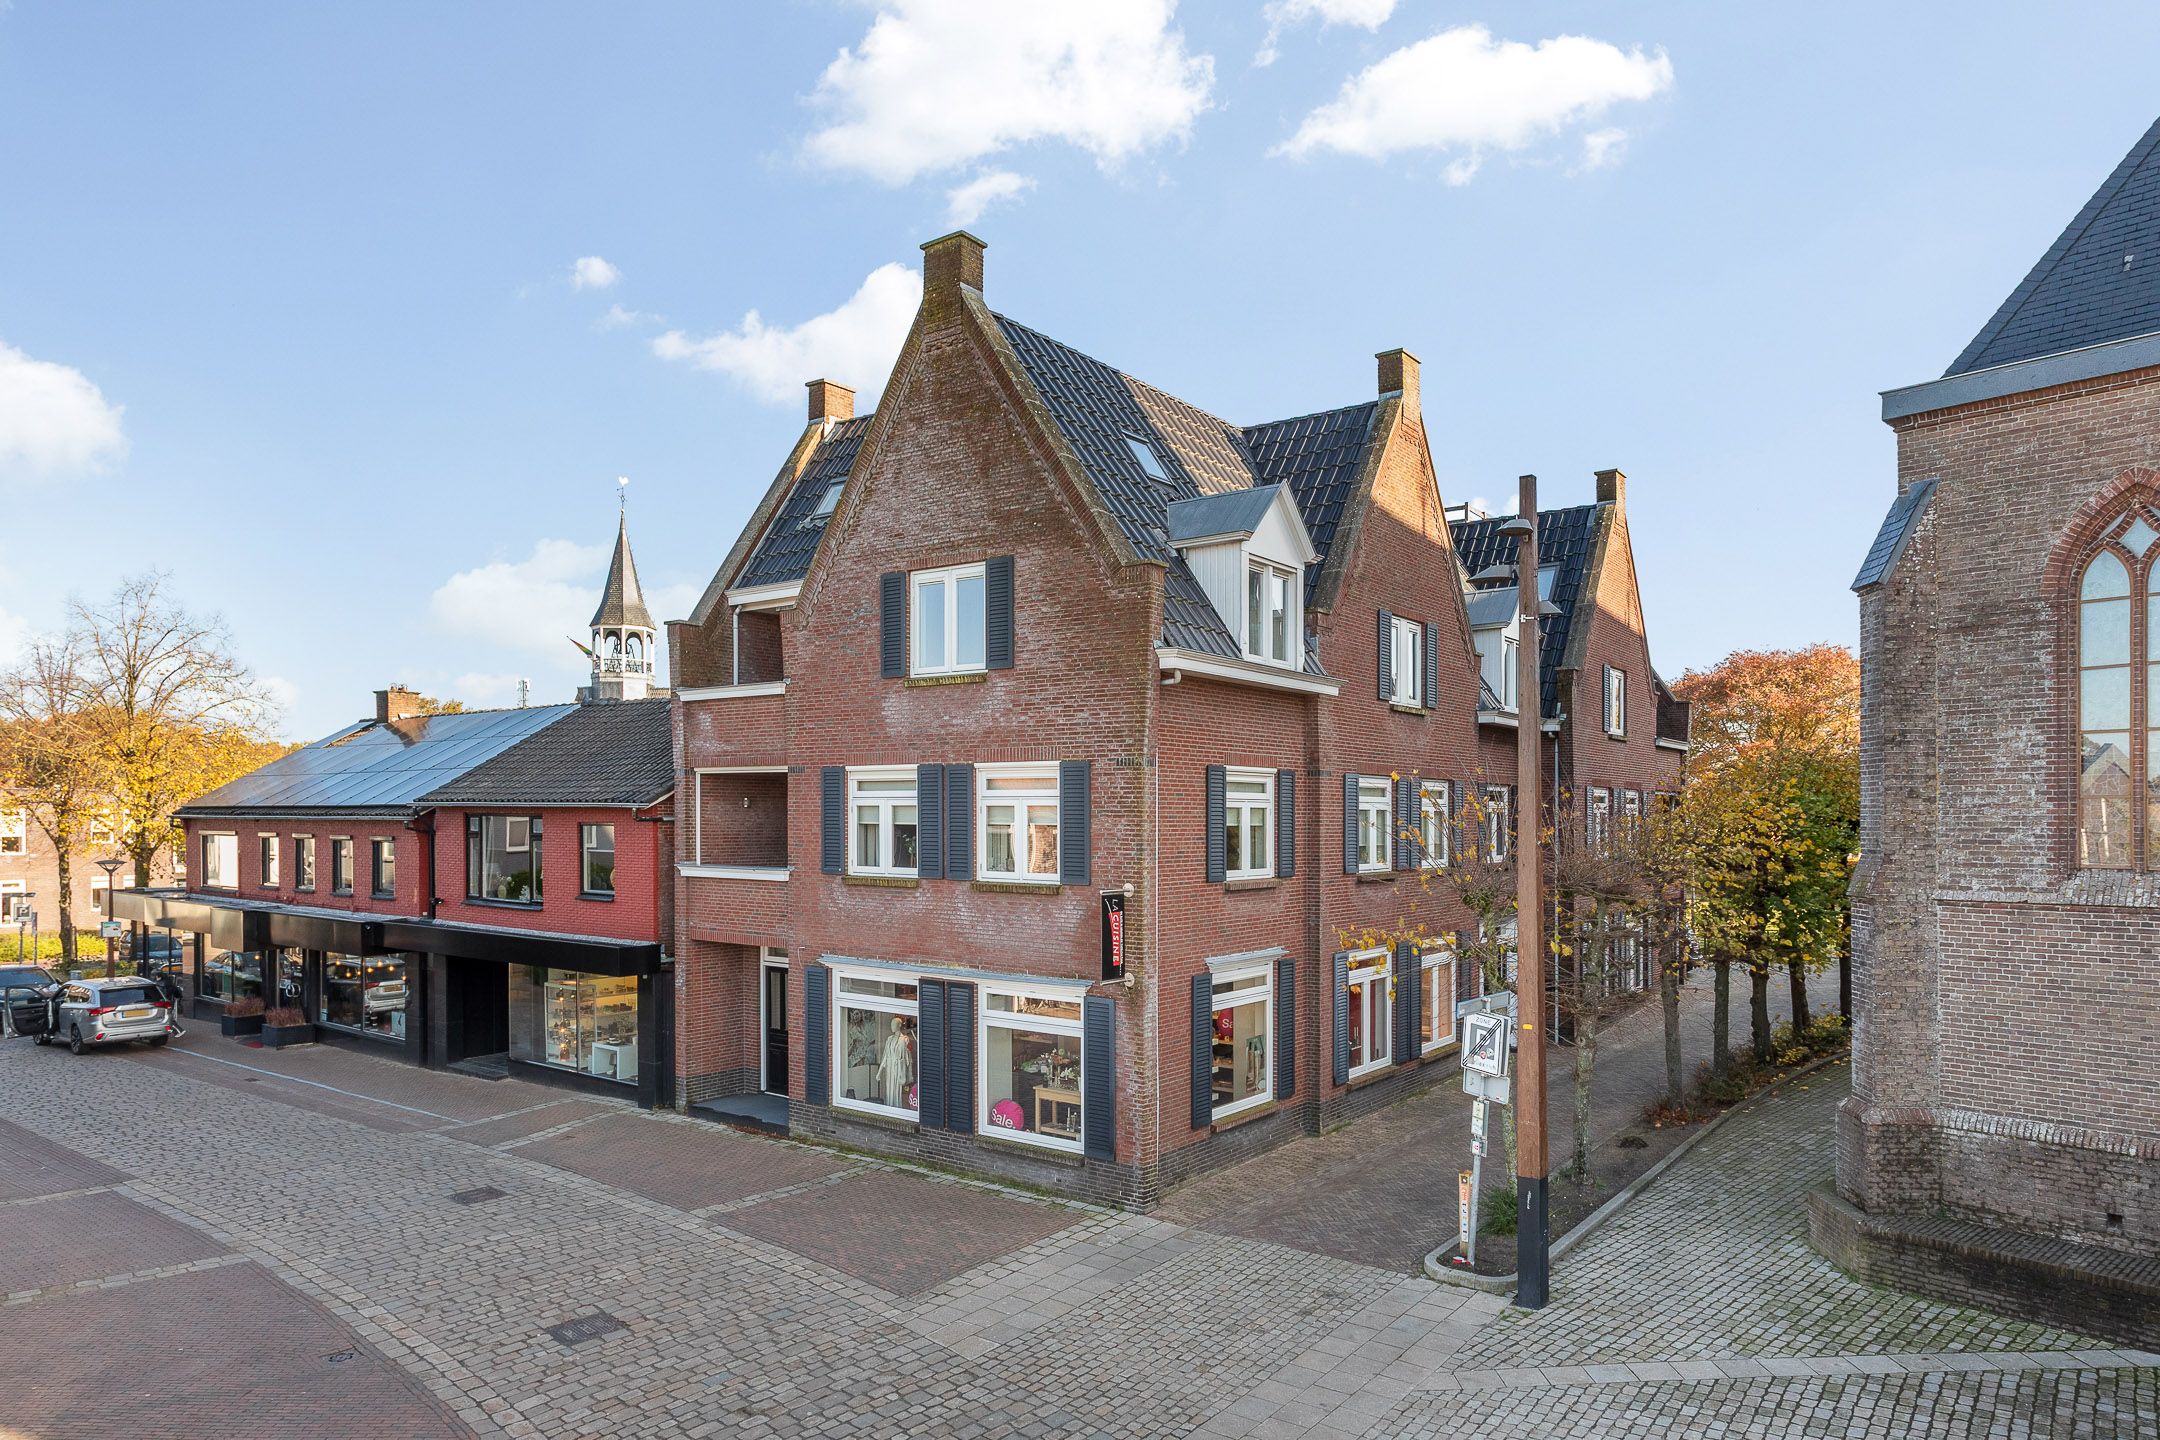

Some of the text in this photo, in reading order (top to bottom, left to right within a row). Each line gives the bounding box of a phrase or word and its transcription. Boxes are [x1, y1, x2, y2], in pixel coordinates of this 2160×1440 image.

[1112, 899, 1119, 911] LA
[1476, 1016, 1491, 1026] ZONE
[991, 1108, 1016, 1129] Sale.
